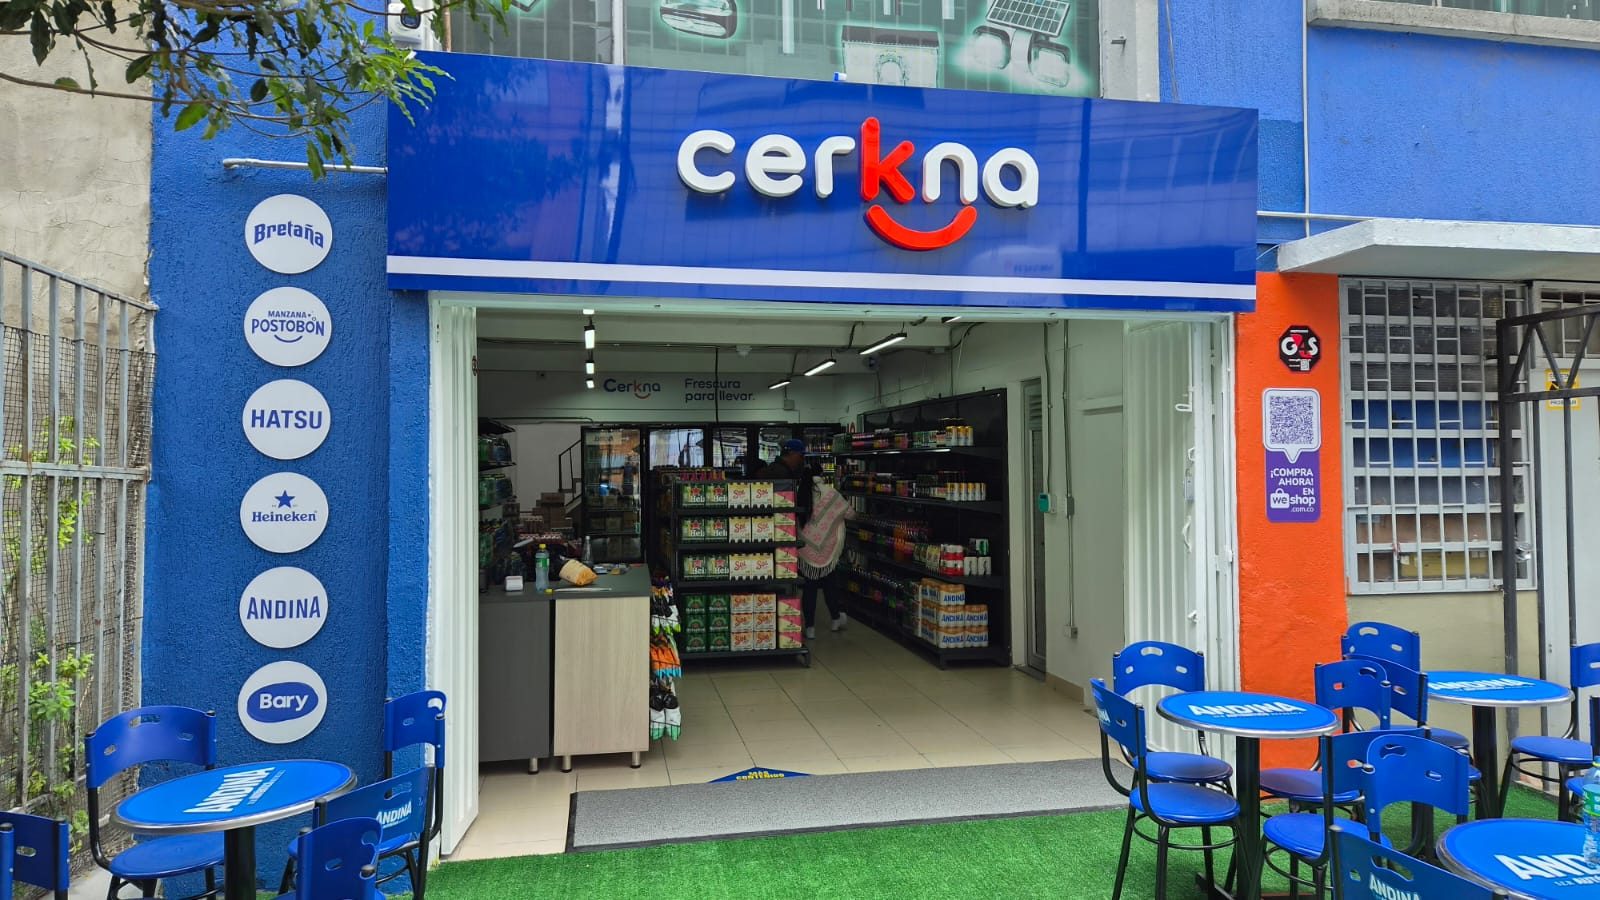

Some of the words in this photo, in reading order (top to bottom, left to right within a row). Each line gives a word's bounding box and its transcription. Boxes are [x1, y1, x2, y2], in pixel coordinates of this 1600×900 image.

[677, 116, 1040, 209] cerkna
[254, 220, 324, 249] Bretaña
[267, 310, 306, 319] MANZANA
[603, 378, 661, 392] Cerkna
[685, 378, 741, 389] Frescura
[685, 391, 716, 403] para
[251, 409, 323, 429] HATSU
[1270, 468, 1314, 478] ¡COMPRA
[1278, 477, 1314, 486] AHORA!
[1302, 487, 1315, 495] EN
[251, 511, 317, 522] Heineken
[247, 596, 321, 620] ANDINA
[259, 693, 309, 712] Bary
[1188, 701, 1307, 716] ANDINA
[183, 766, 276, 813] ANDINA
[376, 800, 412, 824] ANDINA
